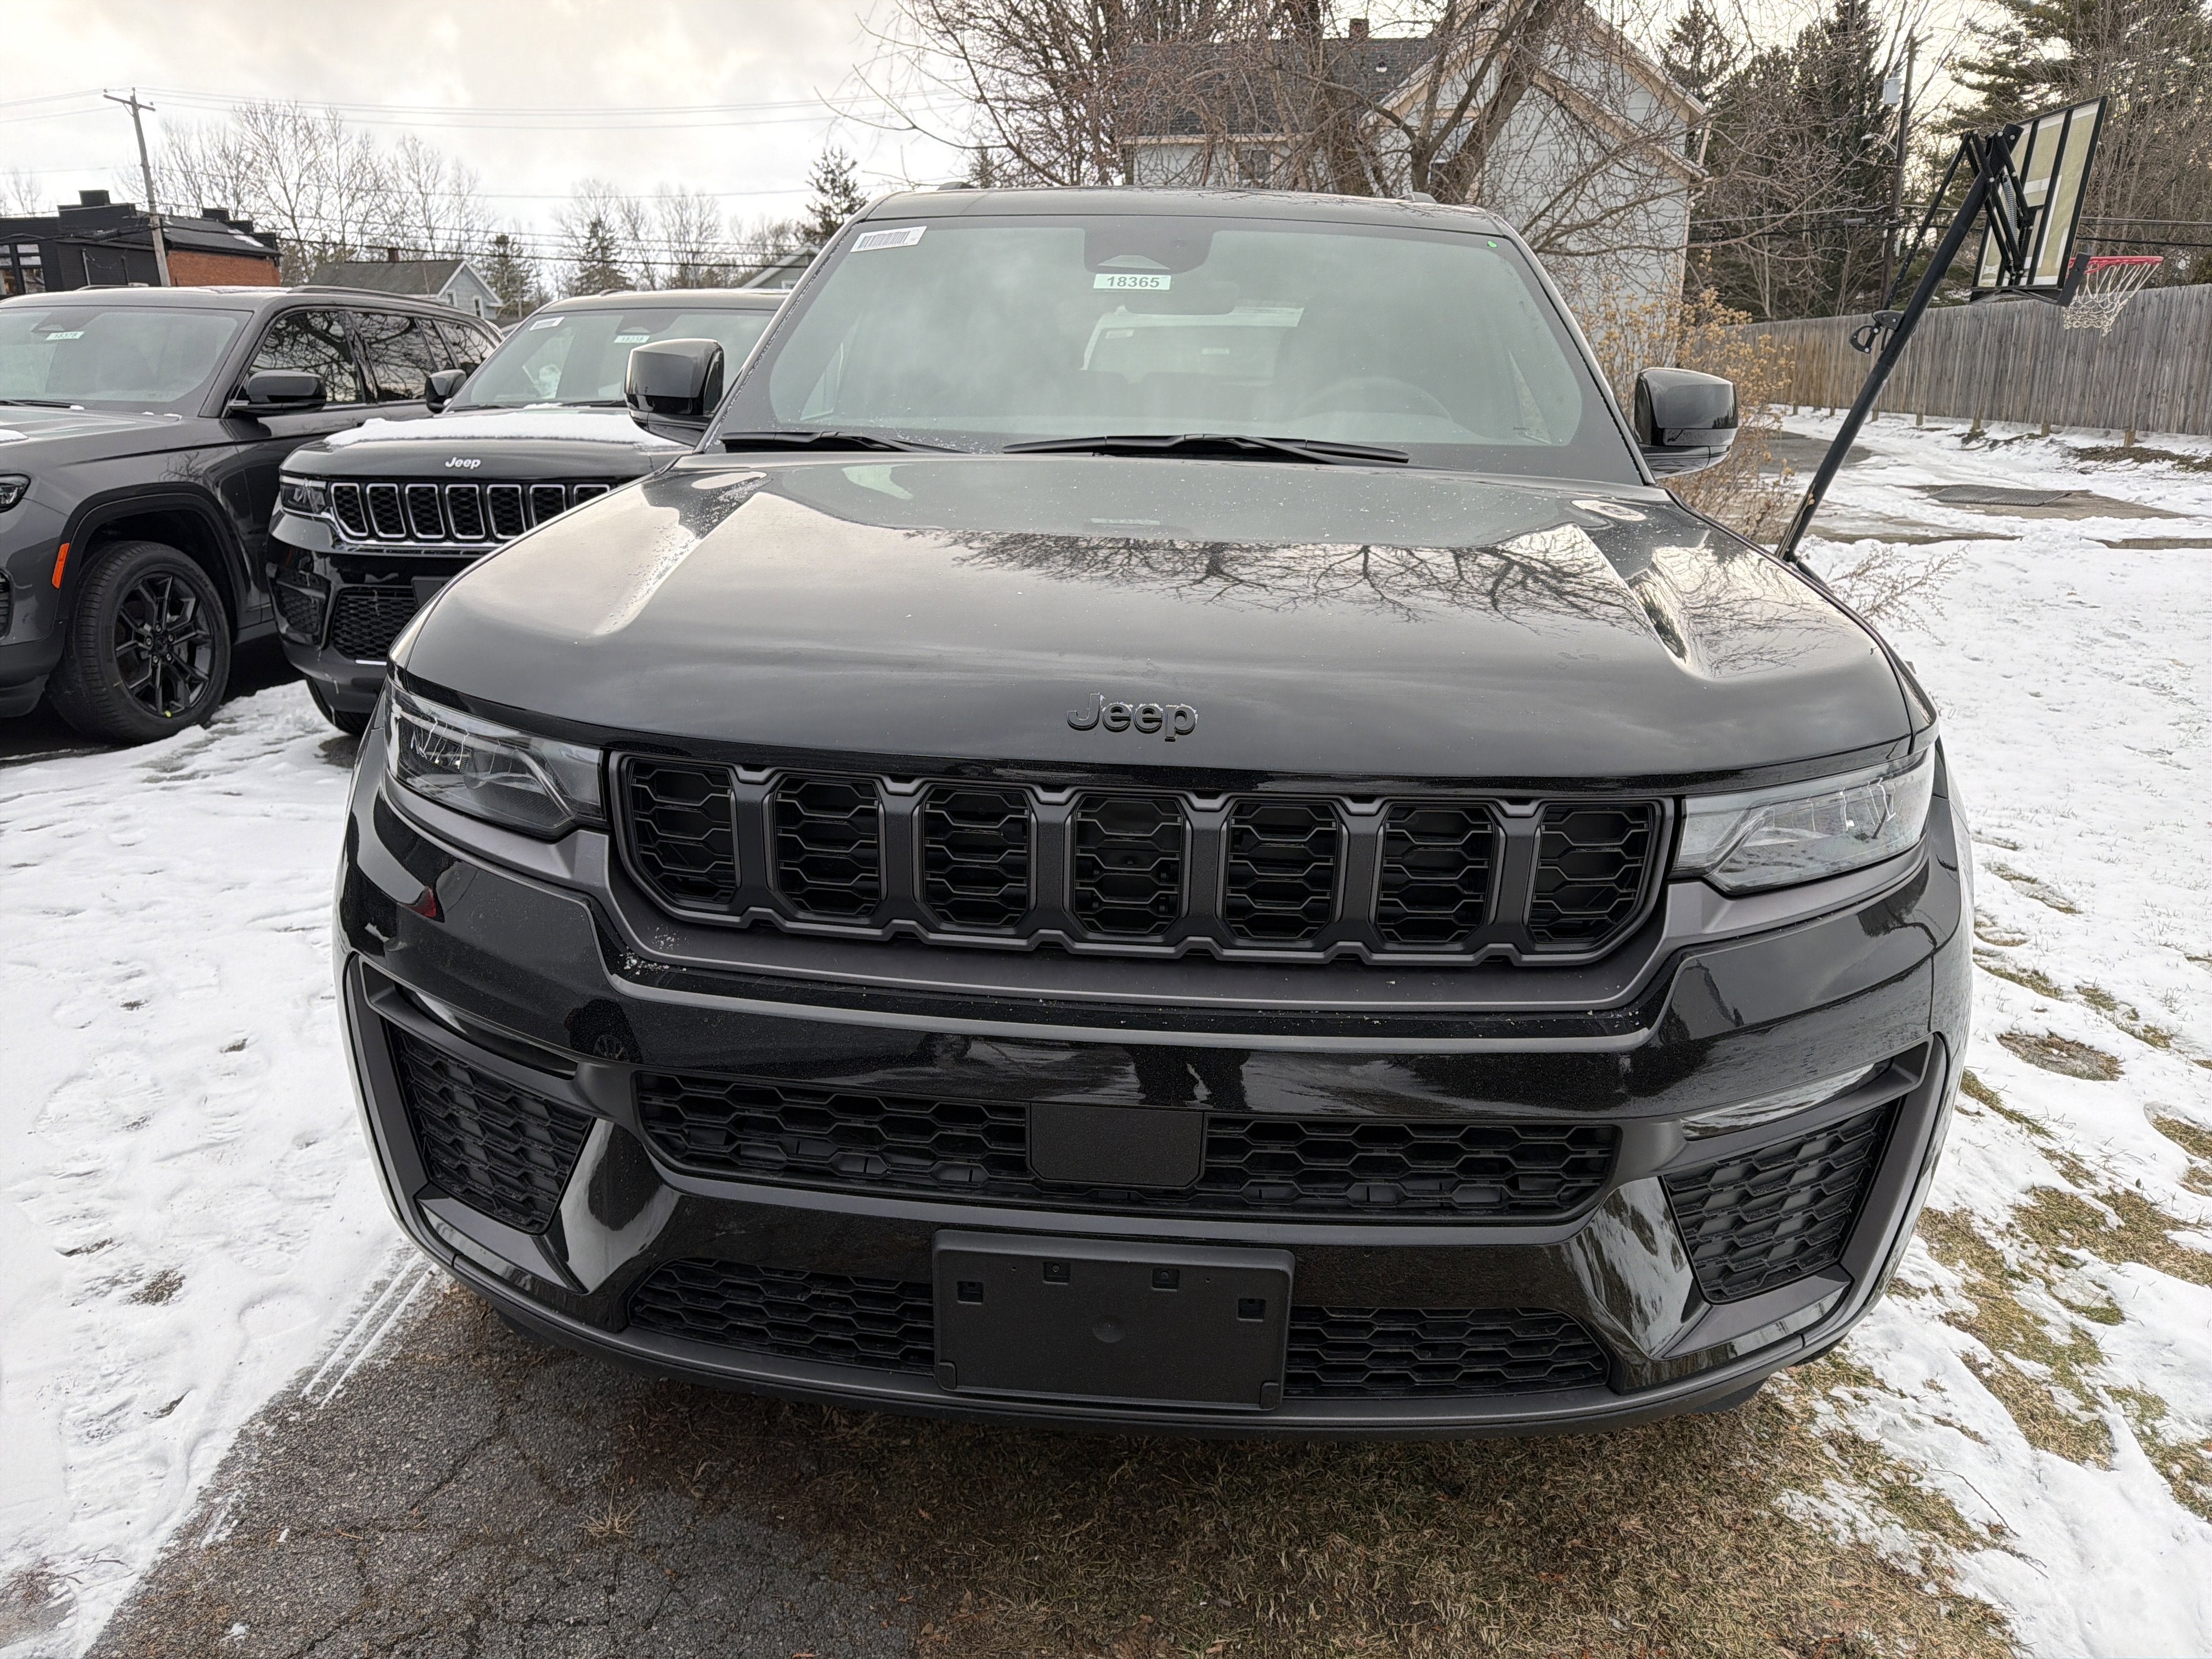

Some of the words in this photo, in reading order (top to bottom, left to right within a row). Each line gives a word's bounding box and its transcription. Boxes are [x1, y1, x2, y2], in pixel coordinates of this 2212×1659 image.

[1107, 276, 1160, 288] 18365
[445, 456, 481, 470] Jeep
[1066, 693, 1198, 742] Jeep
